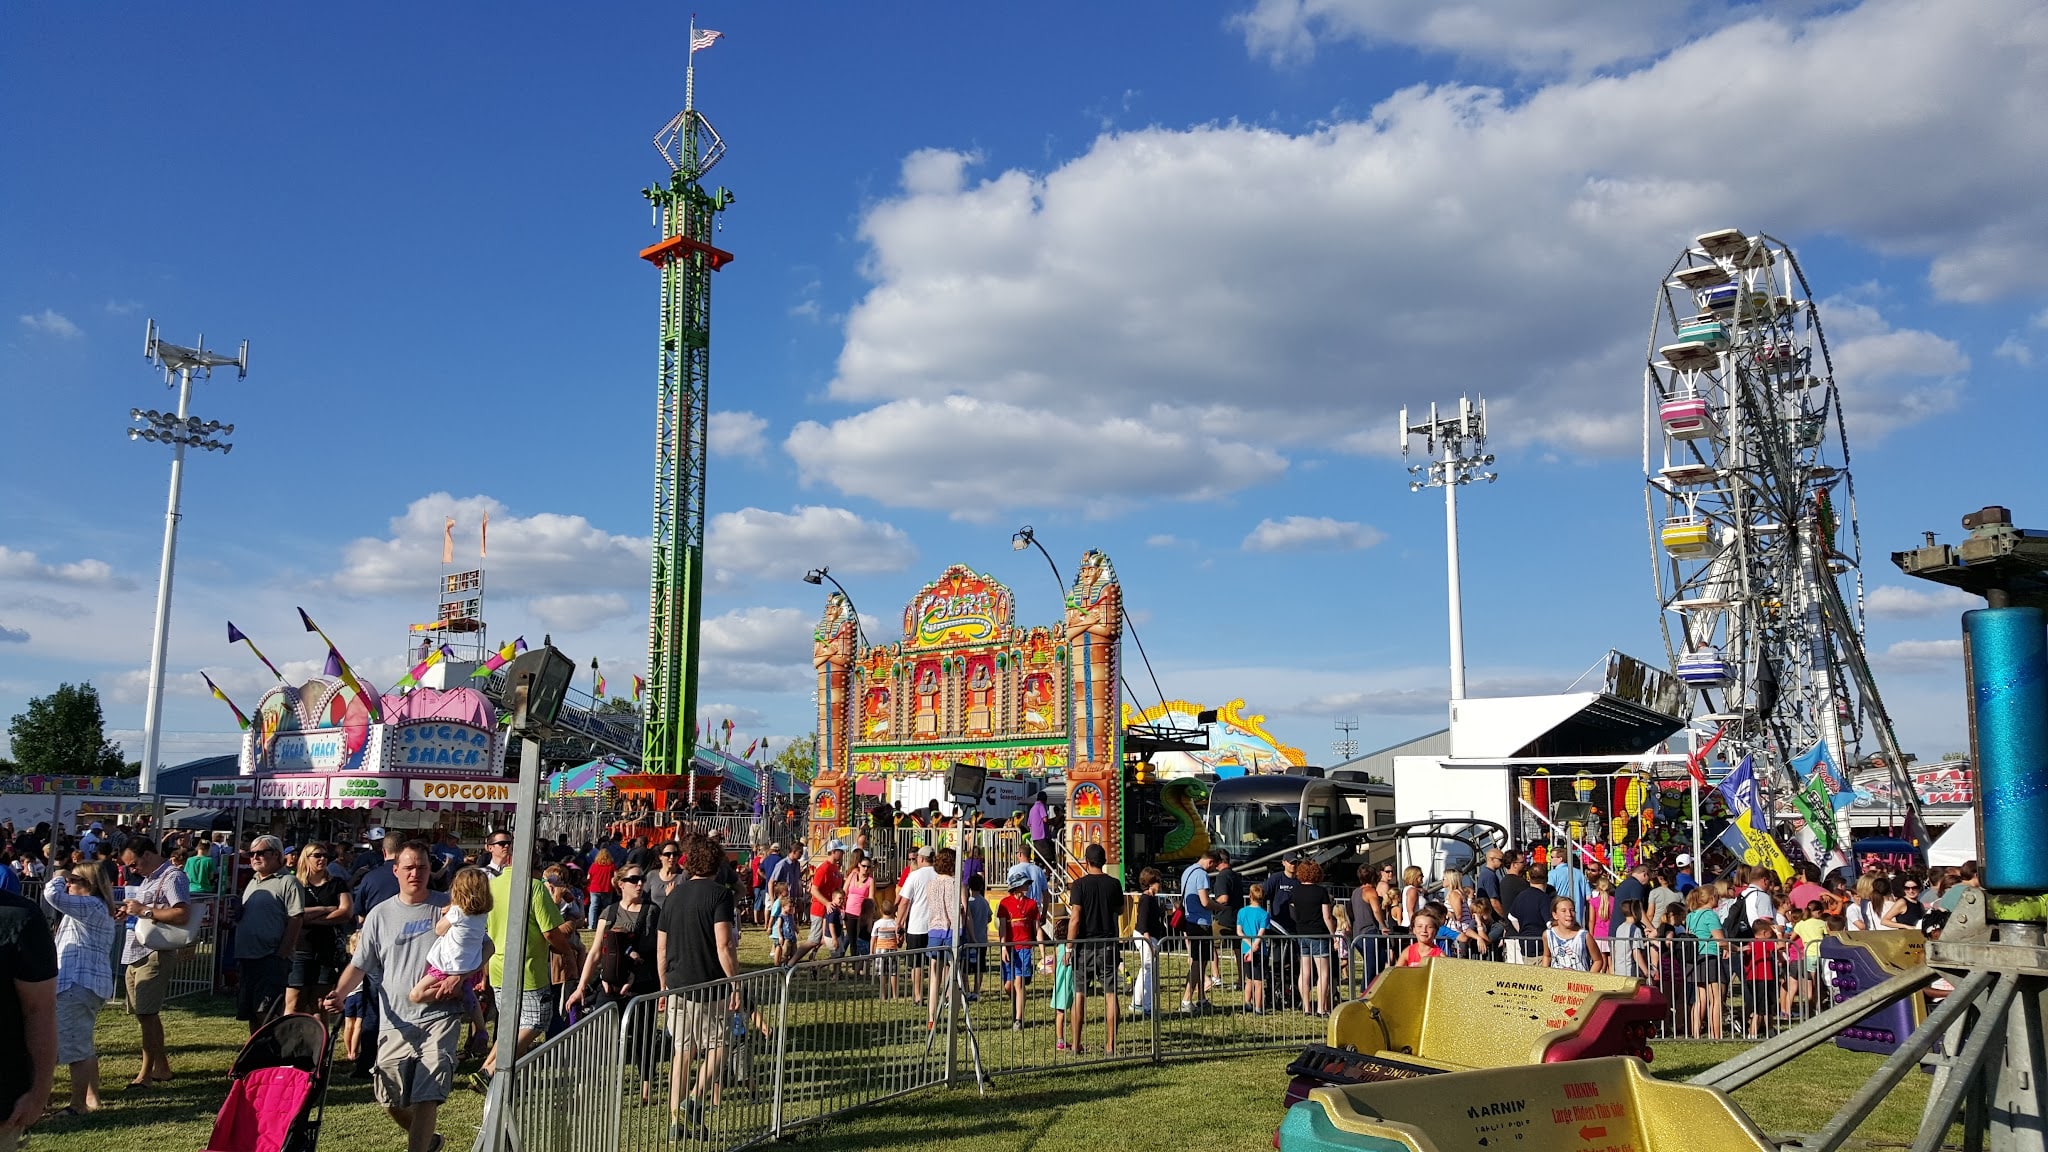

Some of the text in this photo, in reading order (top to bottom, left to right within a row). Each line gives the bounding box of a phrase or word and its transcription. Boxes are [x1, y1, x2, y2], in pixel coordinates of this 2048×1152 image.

[404, 721, 487, 748] SUGAR
[281, 741, 336, 758] SUGAR SHACK
[406, 748, 480, 766] SHACK
[28, 775, 114, 793] TICKETS
[262, 782, 293, 797] COTTON
[296, 782, 325, 797] CANDY
[347, 779, 378, 788] COLD
[423, 782, 509, 800] POPCORN
[339, 788, 387, 797] DRINKS
[402, 918, 432, 935] NIKE
[1496, 980, 1544, 992] WARNING
[1551, 993, 1566, 1004] Large
[1564, 1082, 1599, 1100] WARNING
[1552, 1108, 1571, 1124] Large
[1573, 1105, 1596, 1122] Riders
[1596, 1103, 1611, 1119] This
